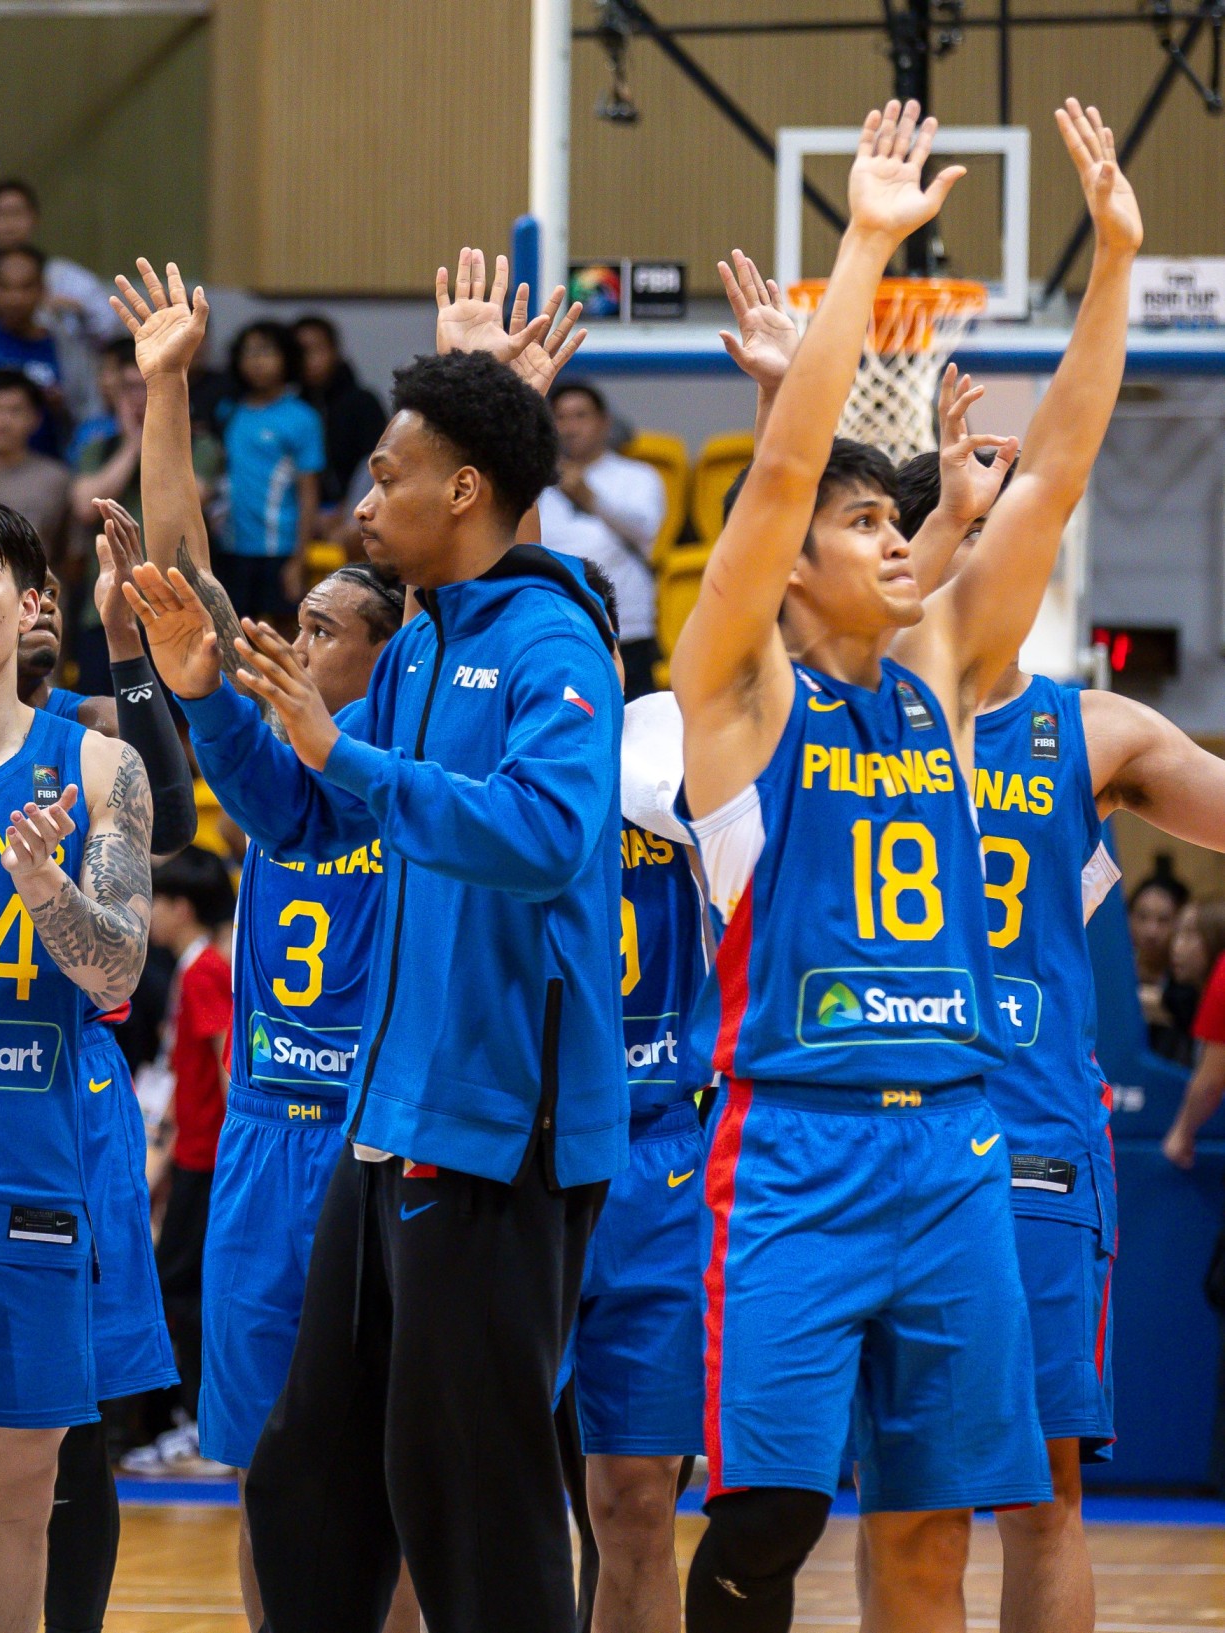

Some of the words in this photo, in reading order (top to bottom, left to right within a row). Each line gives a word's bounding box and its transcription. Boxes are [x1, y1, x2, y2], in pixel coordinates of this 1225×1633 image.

[1034, 738, 1055, 747] FIBA
[37, 790, 58, 798] FIBA
[851, 819, 944, 941] 18
[273, 900, 330, 1007] 3
[864, 988, 967, 1025] Smart
[882, 1090, 922, 1107] PHI
[288, 1104, 320, 1120] PHI
